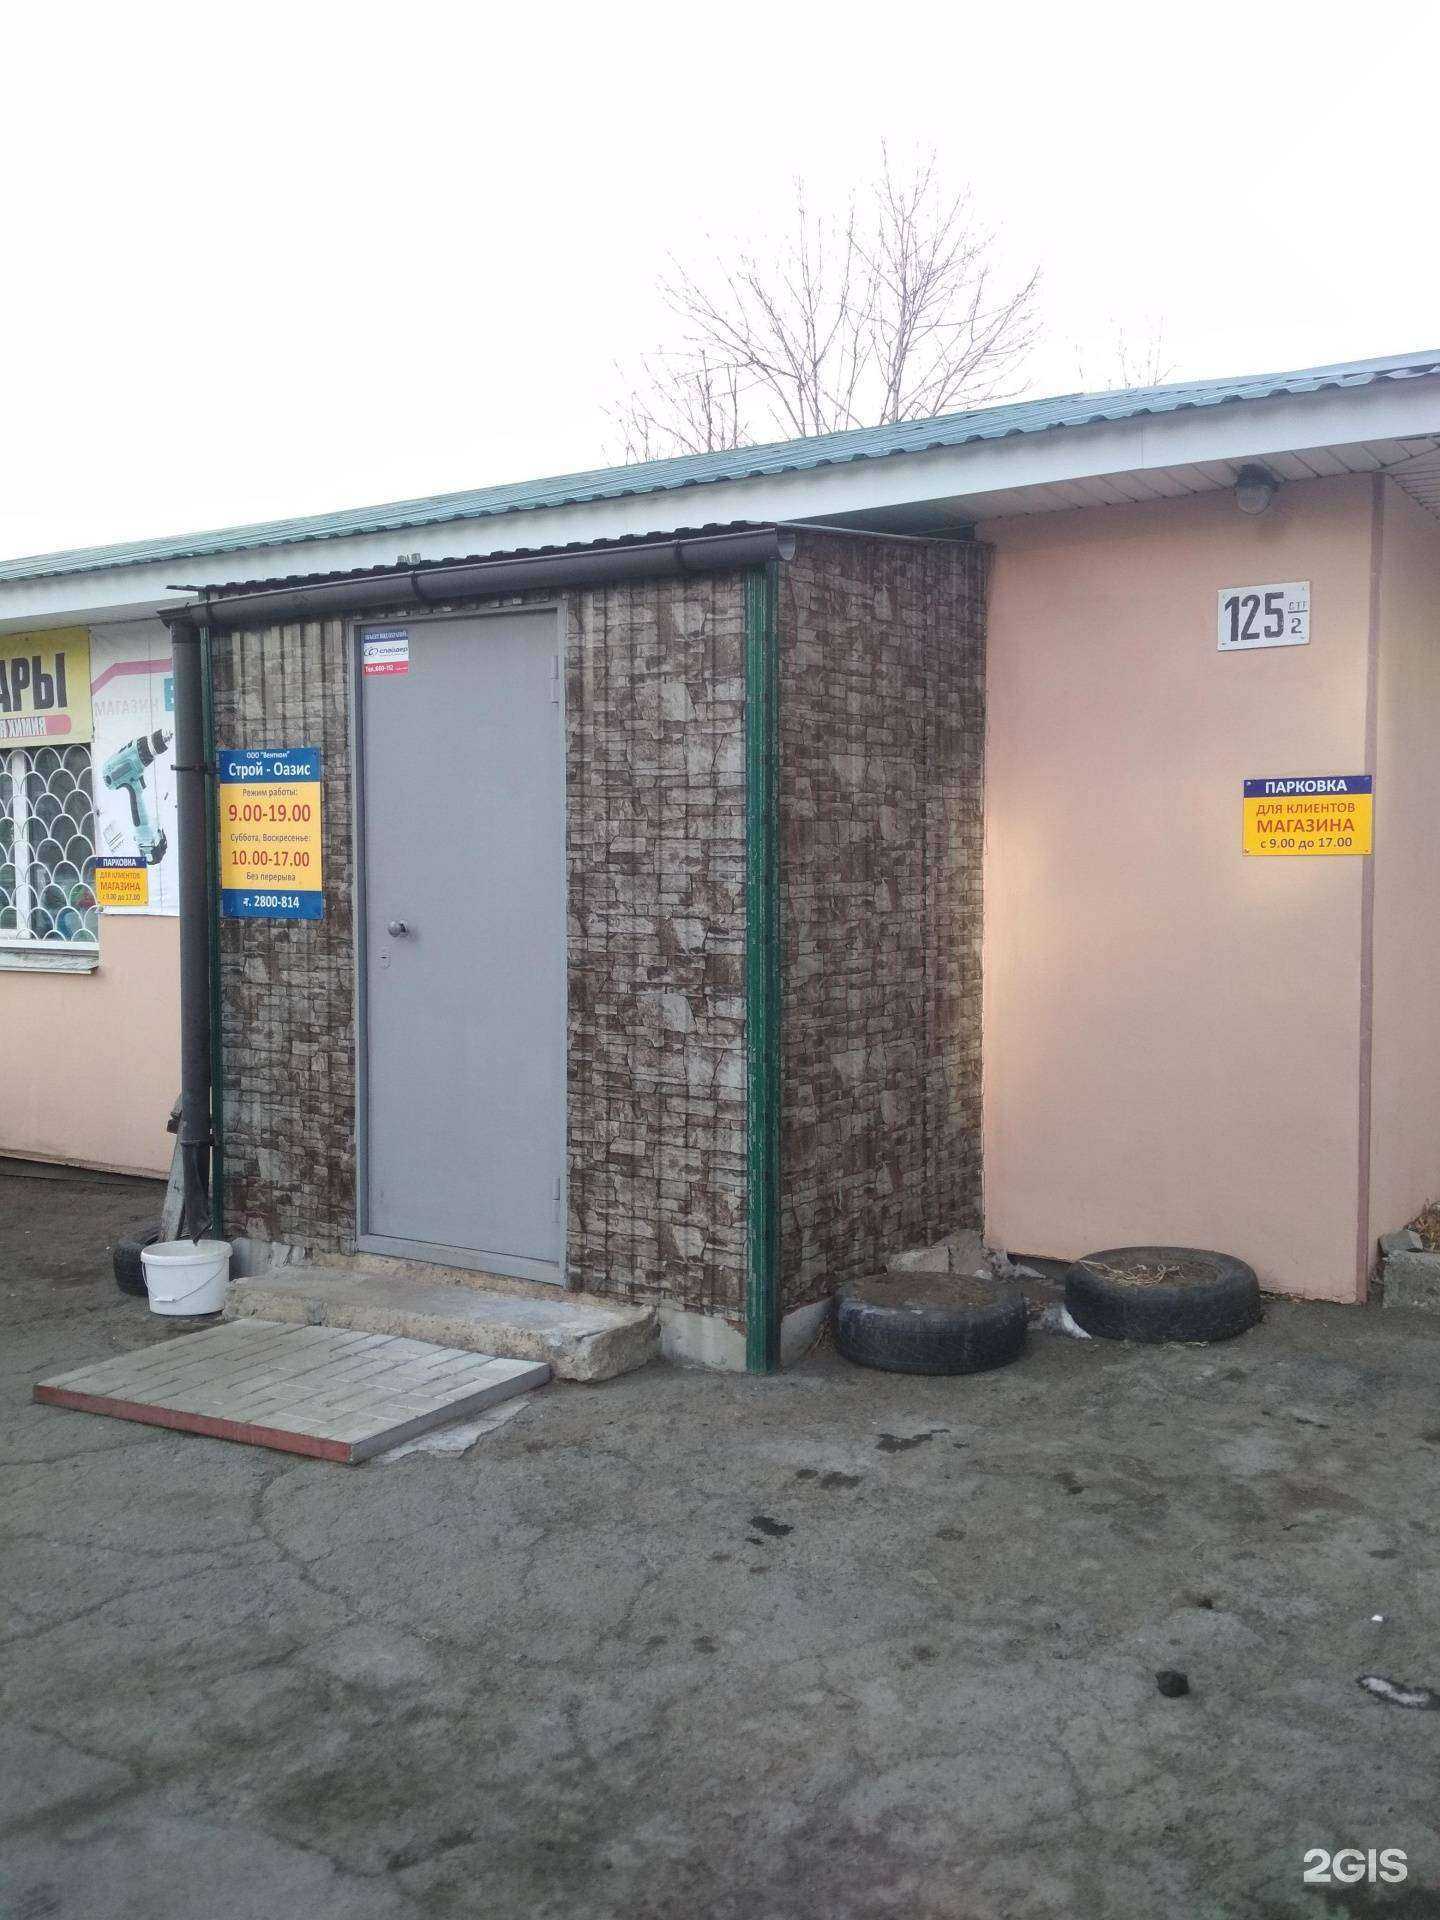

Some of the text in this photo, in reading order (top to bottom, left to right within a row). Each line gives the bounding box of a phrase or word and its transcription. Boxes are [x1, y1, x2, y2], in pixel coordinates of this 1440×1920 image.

[1225, 592, 1284, 642] 125
[1291, 617, 1302, 634] 2
[229, 761, 263, 779] Строй
[273, 762, 311, 776] Оазис
[242, 788, 298, 797] Режим работы:
[1265, 779, 1348, 795] ПАРКОВКА
[228, 804, 311, 822] 9.00-19.00
[1256, 802, 1355, 816] ДЛЯ КЛИЕНТОВ
[1257, 818, 1355, 834] МАГАЗИНА
[262, 834, 311, 843] Воскресенье:
[1260, 837, 1353, 851] с 9.00 до 17.00
[103, 858, 137, 867] ПАРКОВКА
[231, 850, 310, 867] 10.00-17.00
[246, 871, 296, 882] Без перерыва
[100, 881, 141, 891] МАГАЗИНА
[254, 895, 300, 908] 2800-814
